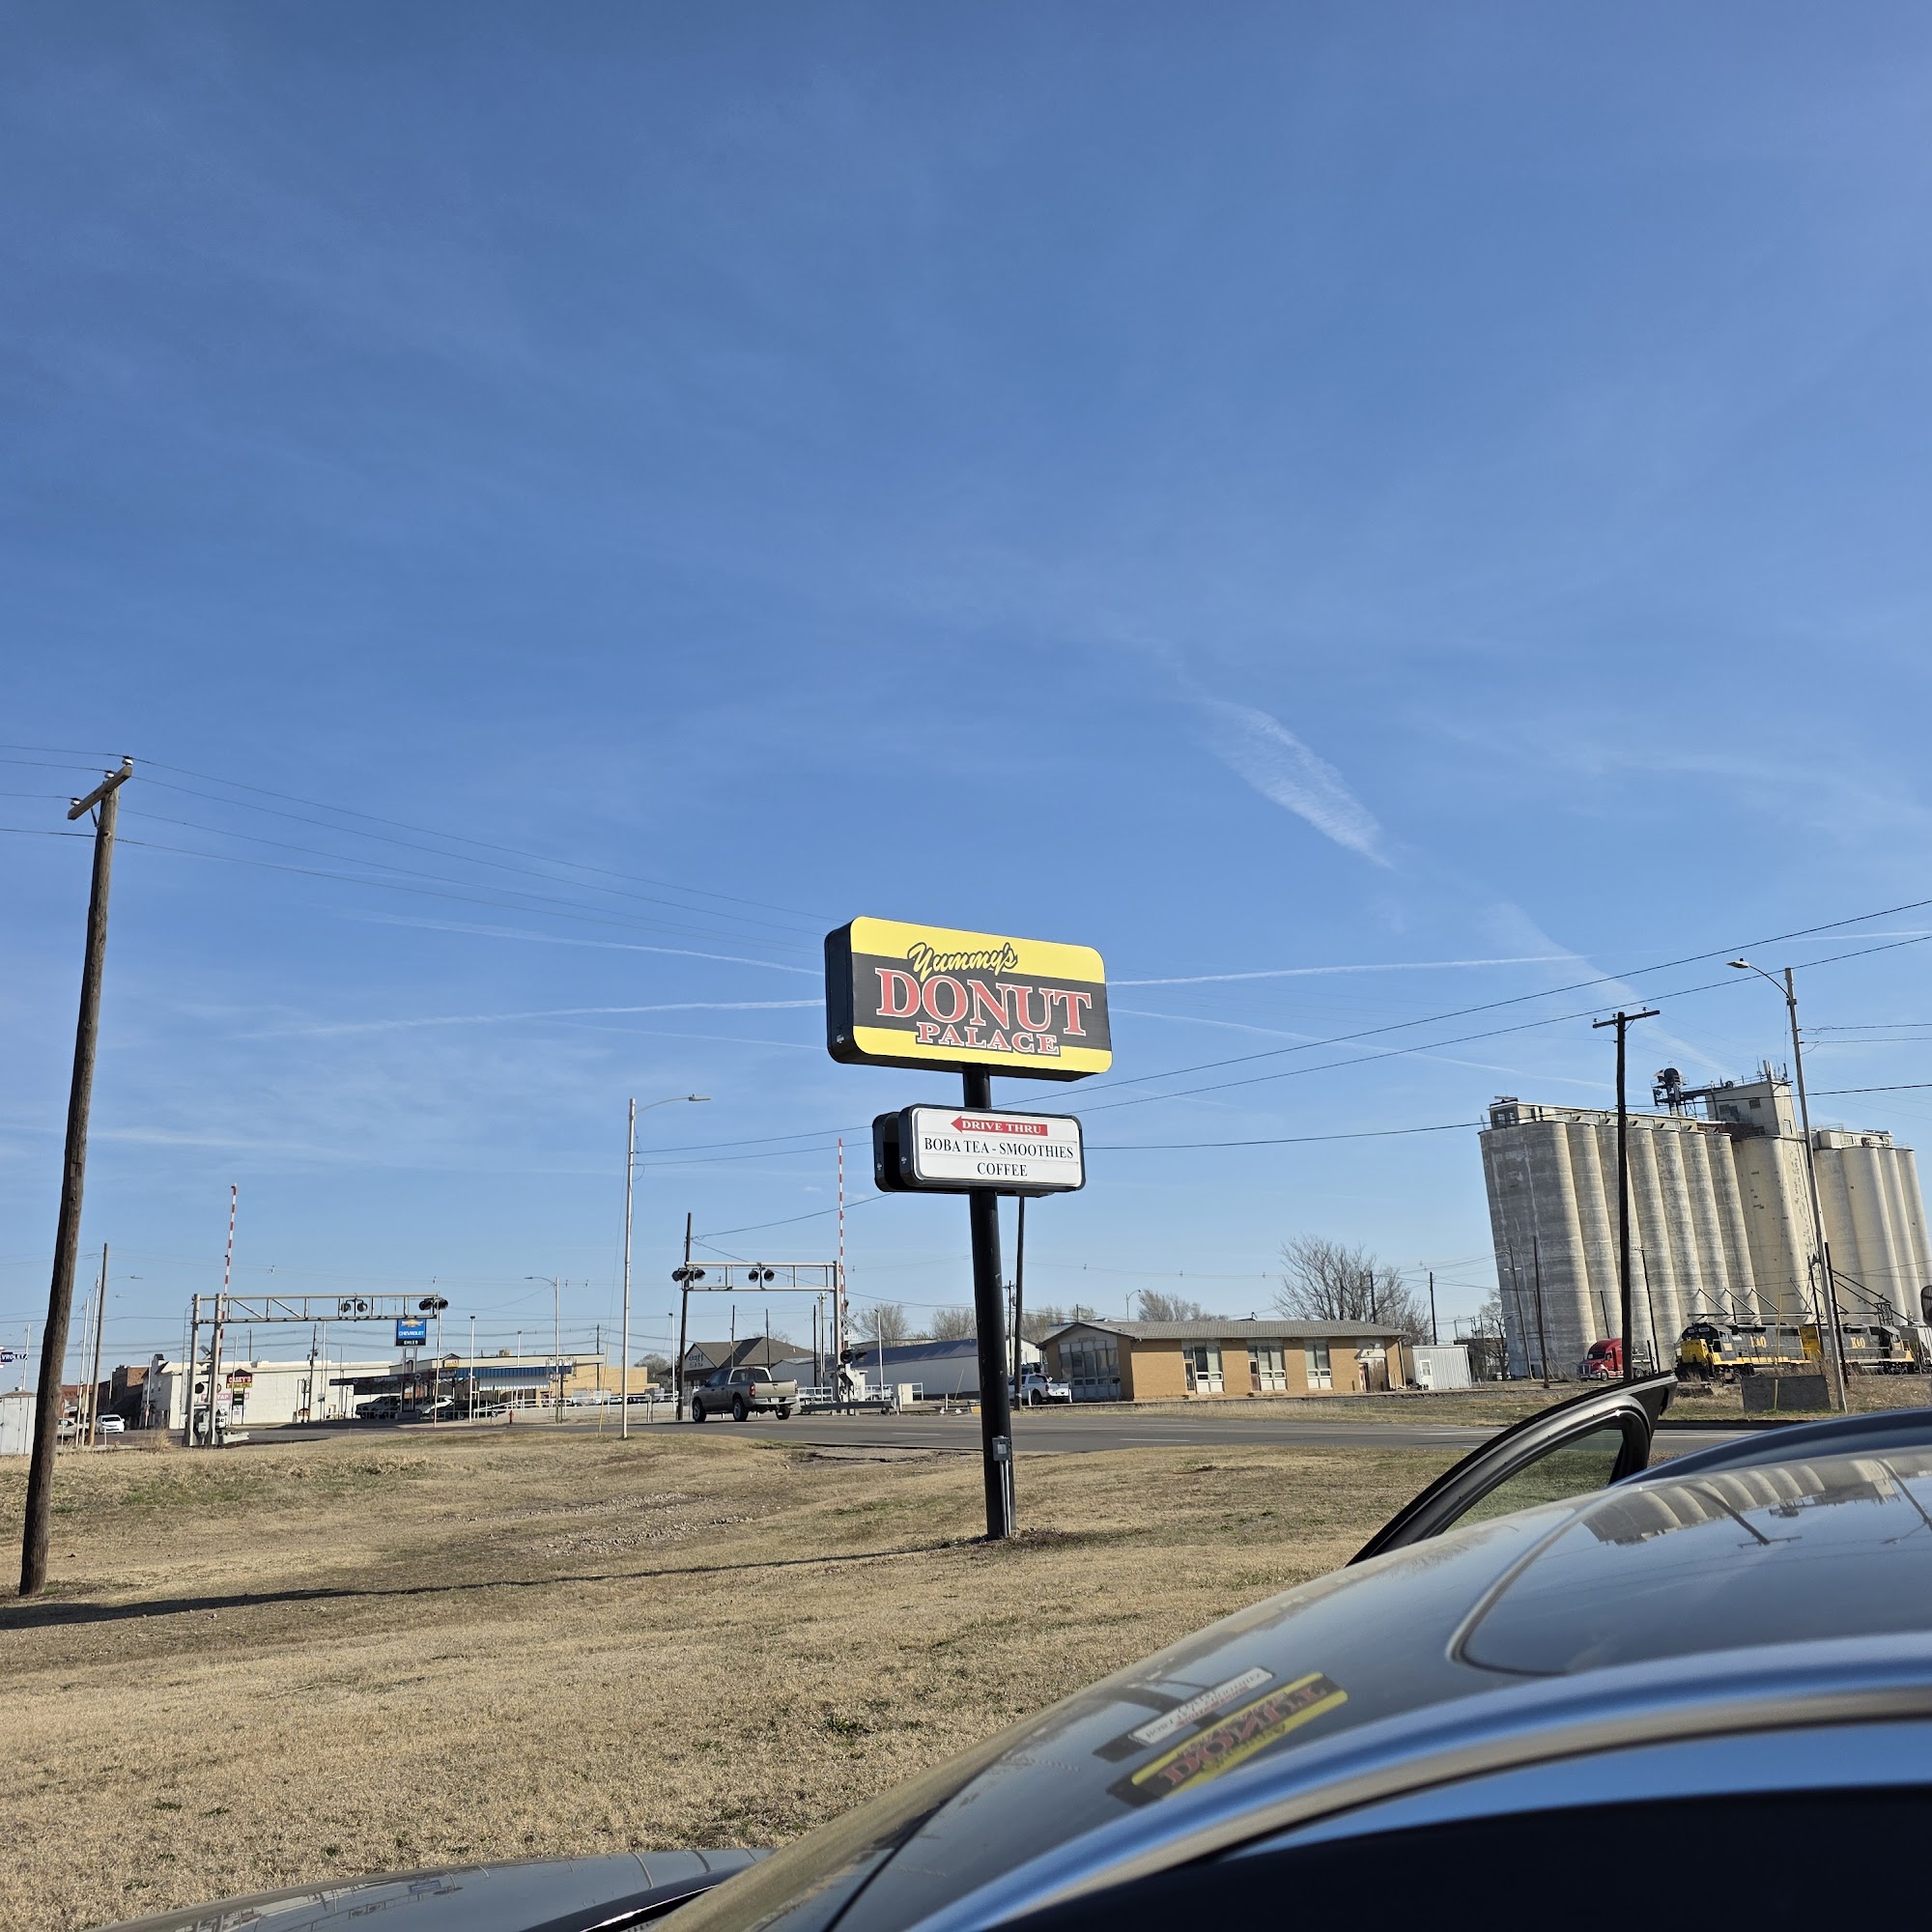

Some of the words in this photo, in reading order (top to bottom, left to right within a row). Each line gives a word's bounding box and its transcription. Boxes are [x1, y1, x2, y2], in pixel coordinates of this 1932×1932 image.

[907, 942, 1018, 982] Yummy's
[874, 967, 1093, 1037] DONUT
[917, 1022, 1061, 1055] PALACE
[962, 1121, 1003, 1132] DRIVE
[1006, 1123, 1041, 1134] THRU
[924, 1137, 961, 1152] BOBA
[963, 1140, 990, 1153] TEA
[999, 1142, 1074, 1158] SMOOTHIES
[977, 1162, 1028, 1177] COFFEE
